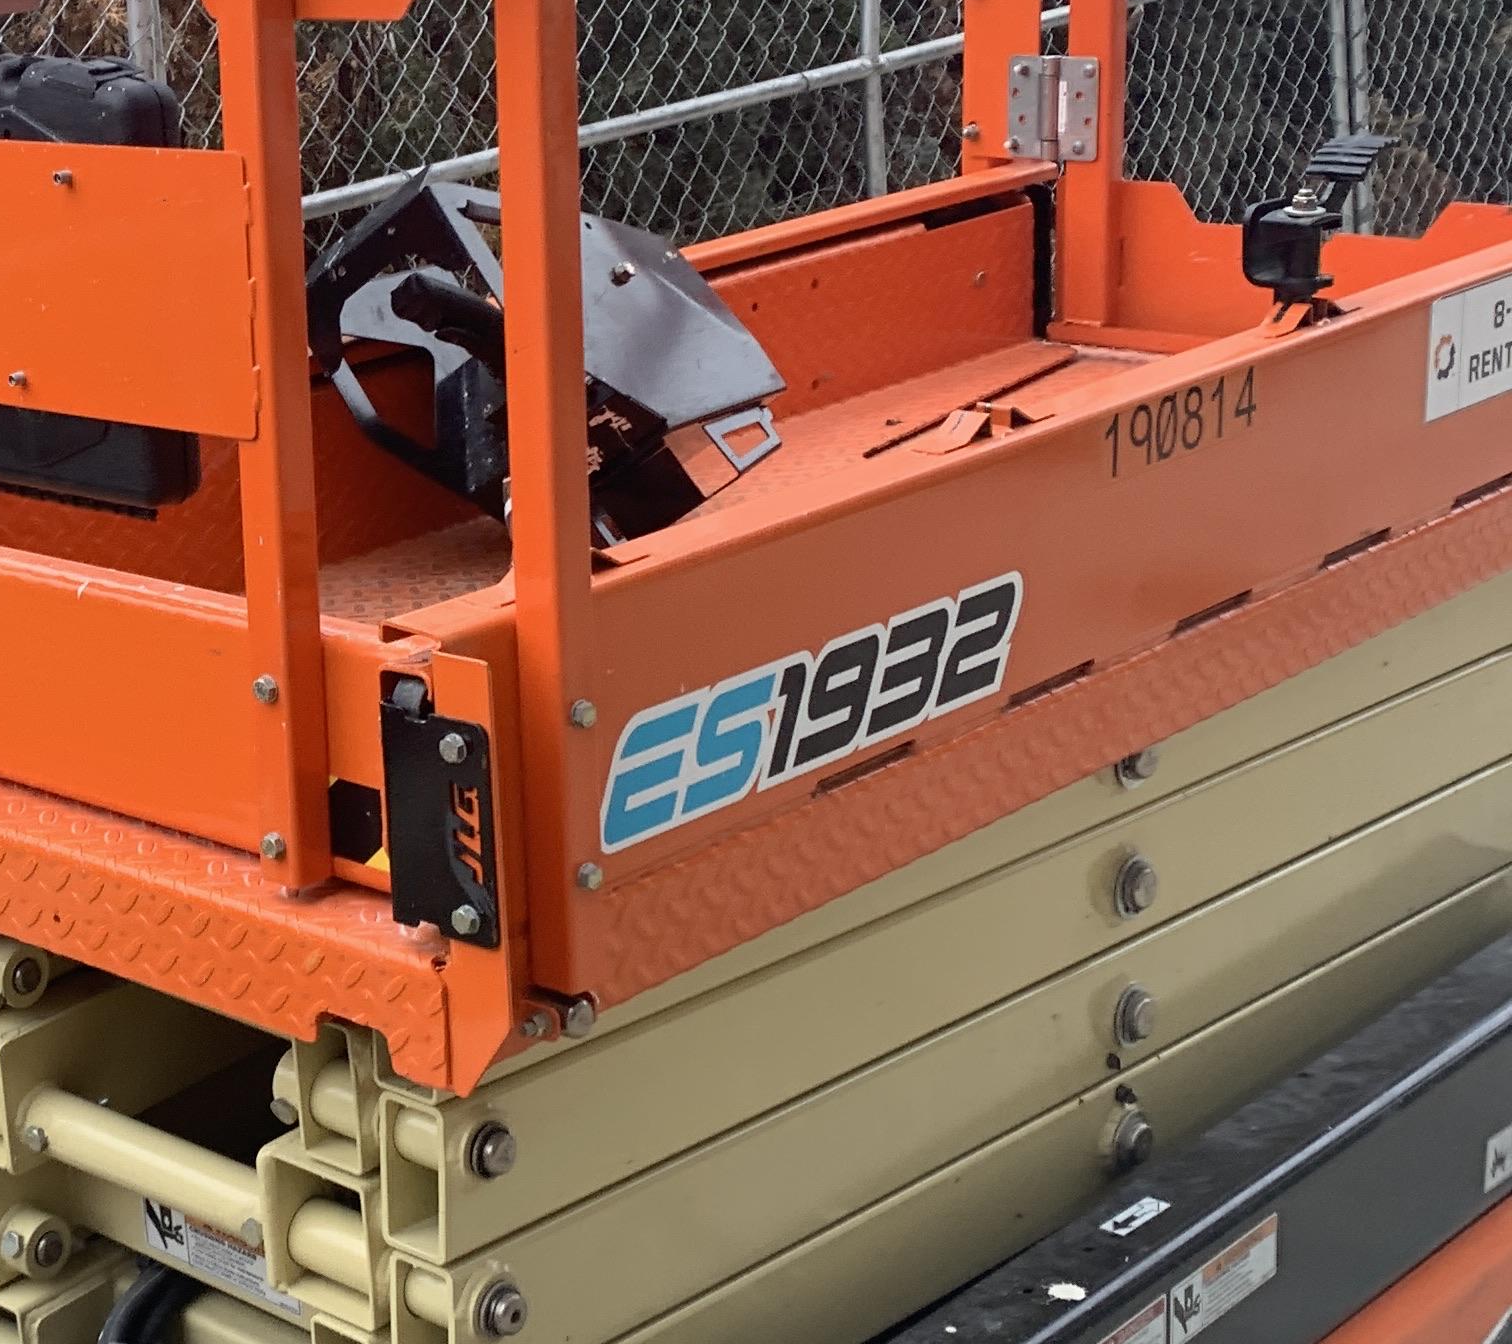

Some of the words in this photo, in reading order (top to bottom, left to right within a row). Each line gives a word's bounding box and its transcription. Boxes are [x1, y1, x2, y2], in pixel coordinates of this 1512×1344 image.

[1104, 365, 1257, 478] 190814
[602, 576, 1019, 848] ES1932
[453, 782, 485, 886] JLG
